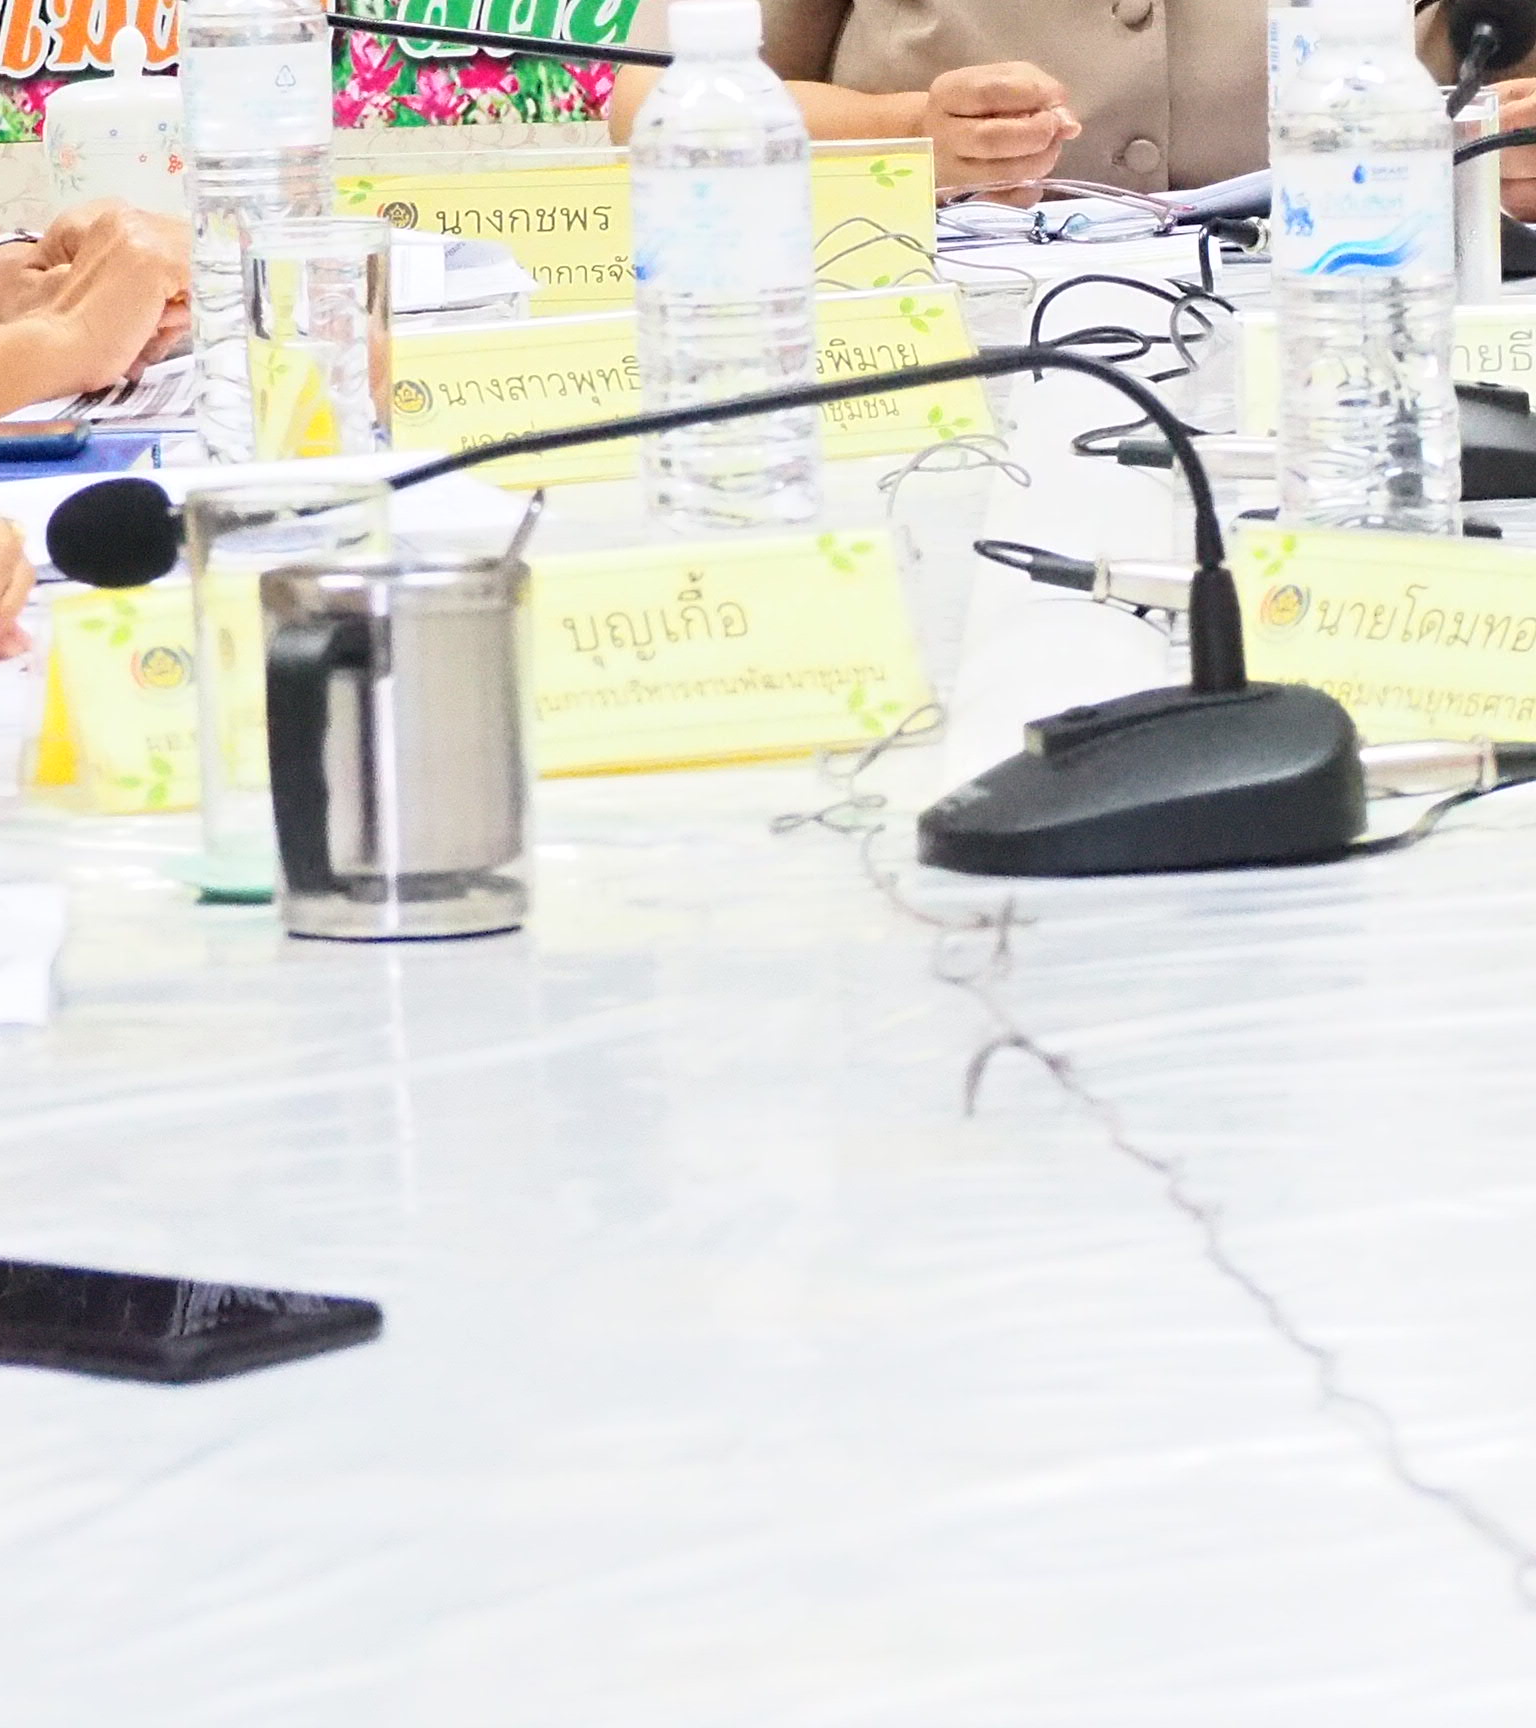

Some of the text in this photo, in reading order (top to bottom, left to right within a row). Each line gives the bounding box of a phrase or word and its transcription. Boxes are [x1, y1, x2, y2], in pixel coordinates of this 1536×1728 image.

[435, 205, 612, 235] นางกชพร
[560, 569, 751, 671] บุญเกื้อ
